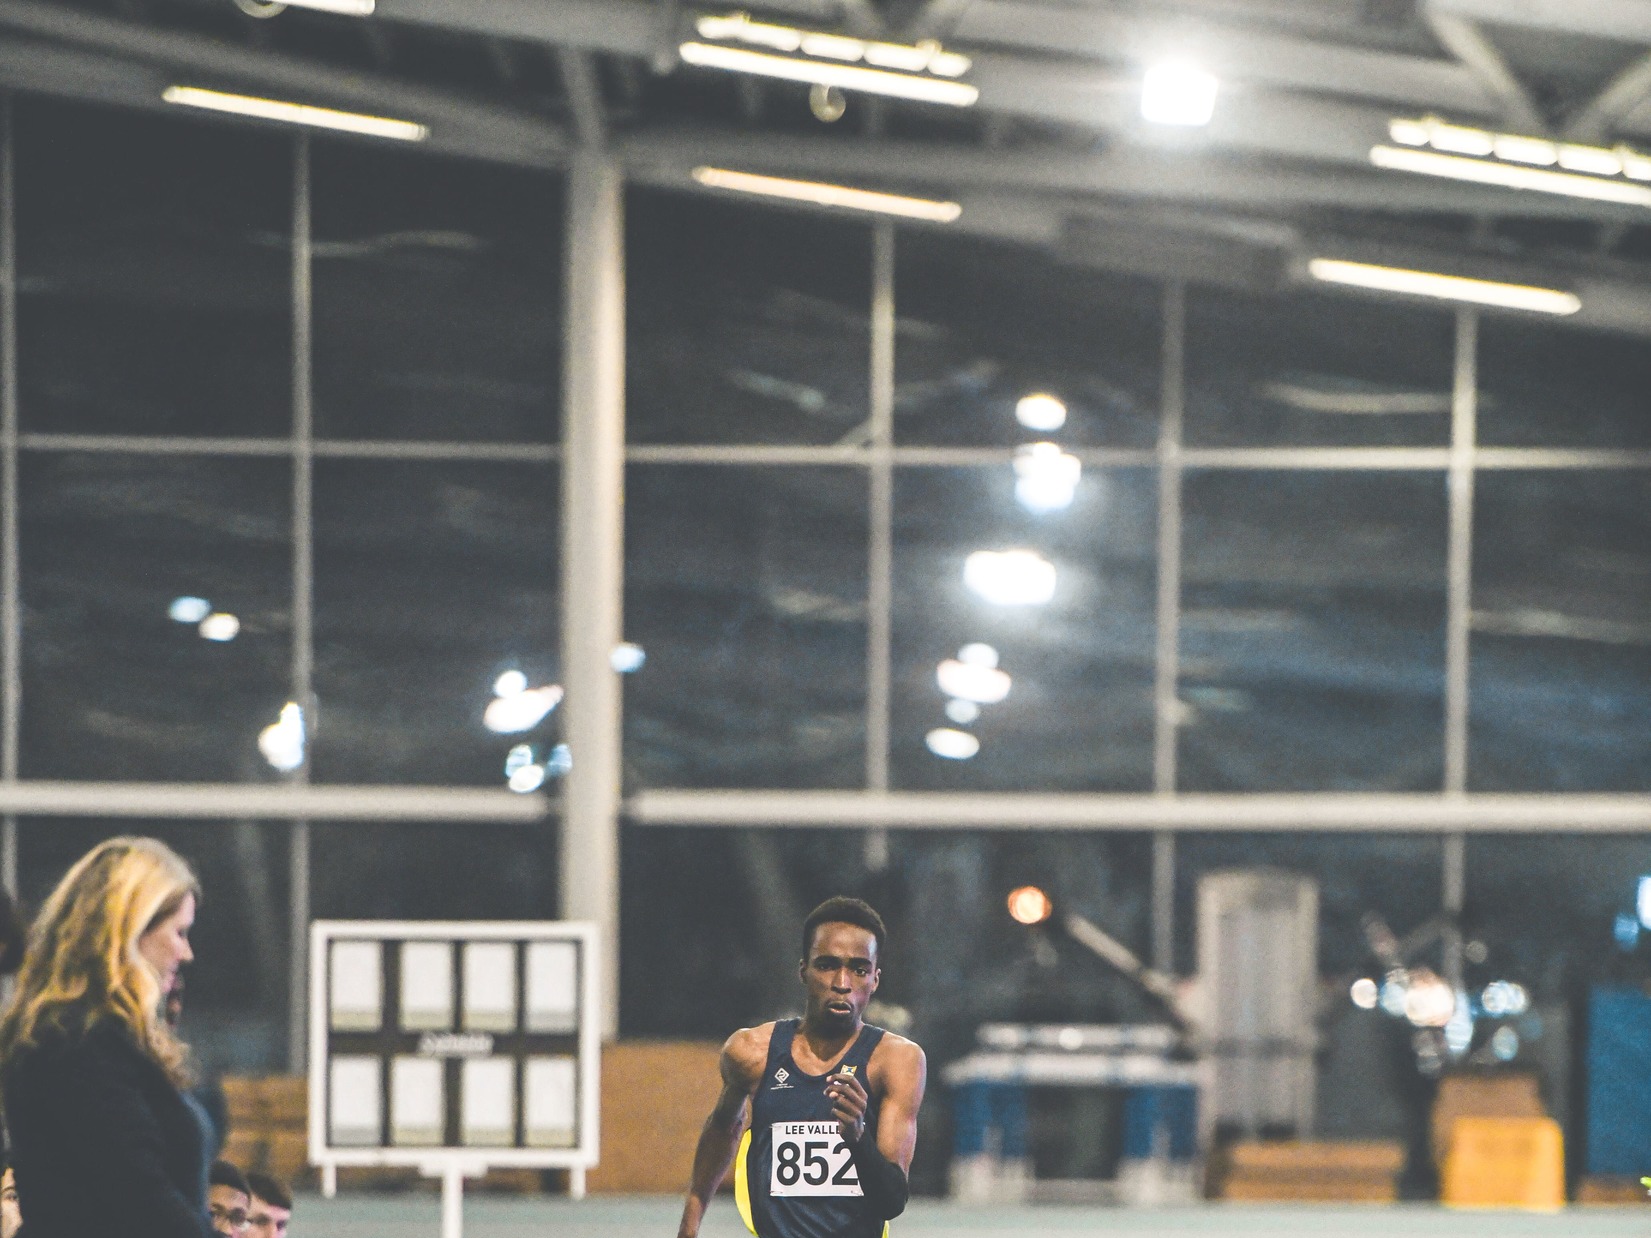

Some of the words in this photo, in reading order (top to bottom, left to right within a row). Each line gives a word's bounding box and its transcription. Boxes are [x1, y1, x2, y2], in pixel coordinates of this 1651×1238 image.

[785, 1125, 805, 1135] LEE
[807, 1125, 840, 1135] VALLE
[776, 1141, 859, 1186] 852
